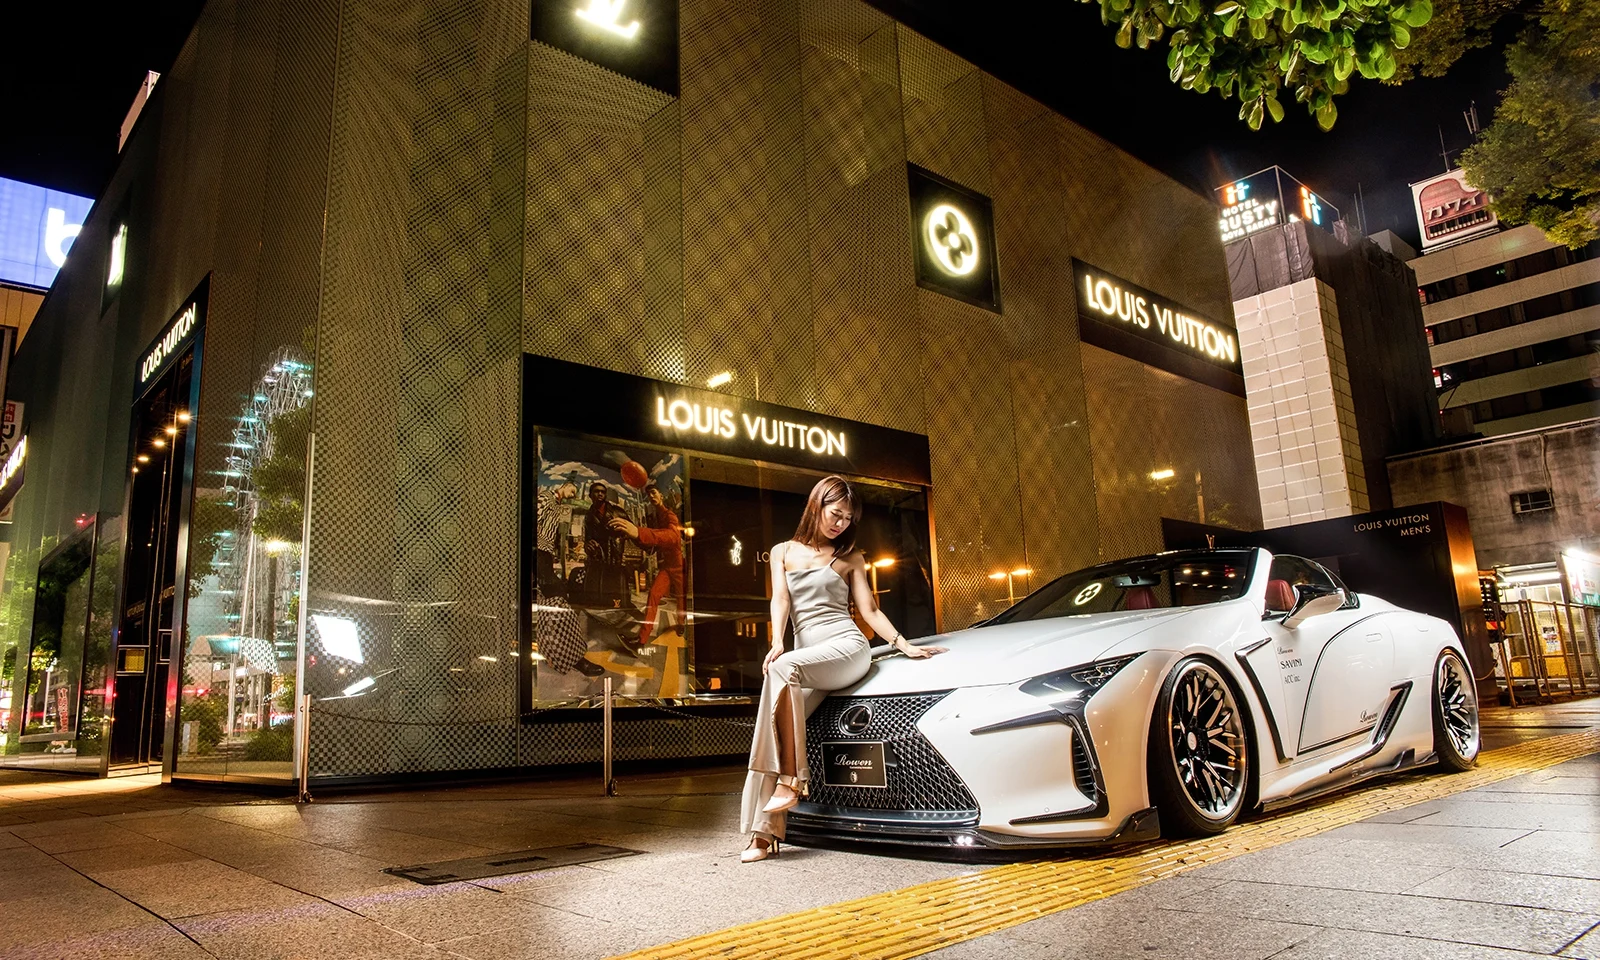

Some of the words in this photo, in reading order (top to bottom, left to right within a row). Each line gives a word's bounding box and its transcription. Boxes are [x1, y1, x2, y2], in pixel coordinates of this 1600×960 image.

[1219, 200, 1278, 233] RUSTY
[1222, 199, 1260, 218] HOTEL
[1426, 192, 1481, 220] カワイ
[1085, 274, 1150, 330] LOUIS
[1152, 303, 1235, 363] VUITTON
[141, 343, 162, 382] LOUIS
[162, 302, 197, 357] VUITTON
[657, 397, 736, 438] LOUIS
[742, 413, 846, 457] VUITTON
[1353, 520, 1382, 532] LOUIS
[1384, 513, 1430, 527] VUITTON
[1400, 525, 1431, 536] MEN'S
[1280, 658, 1303, 669] SAVINI
[834, 754, 872, 766] Rowen
